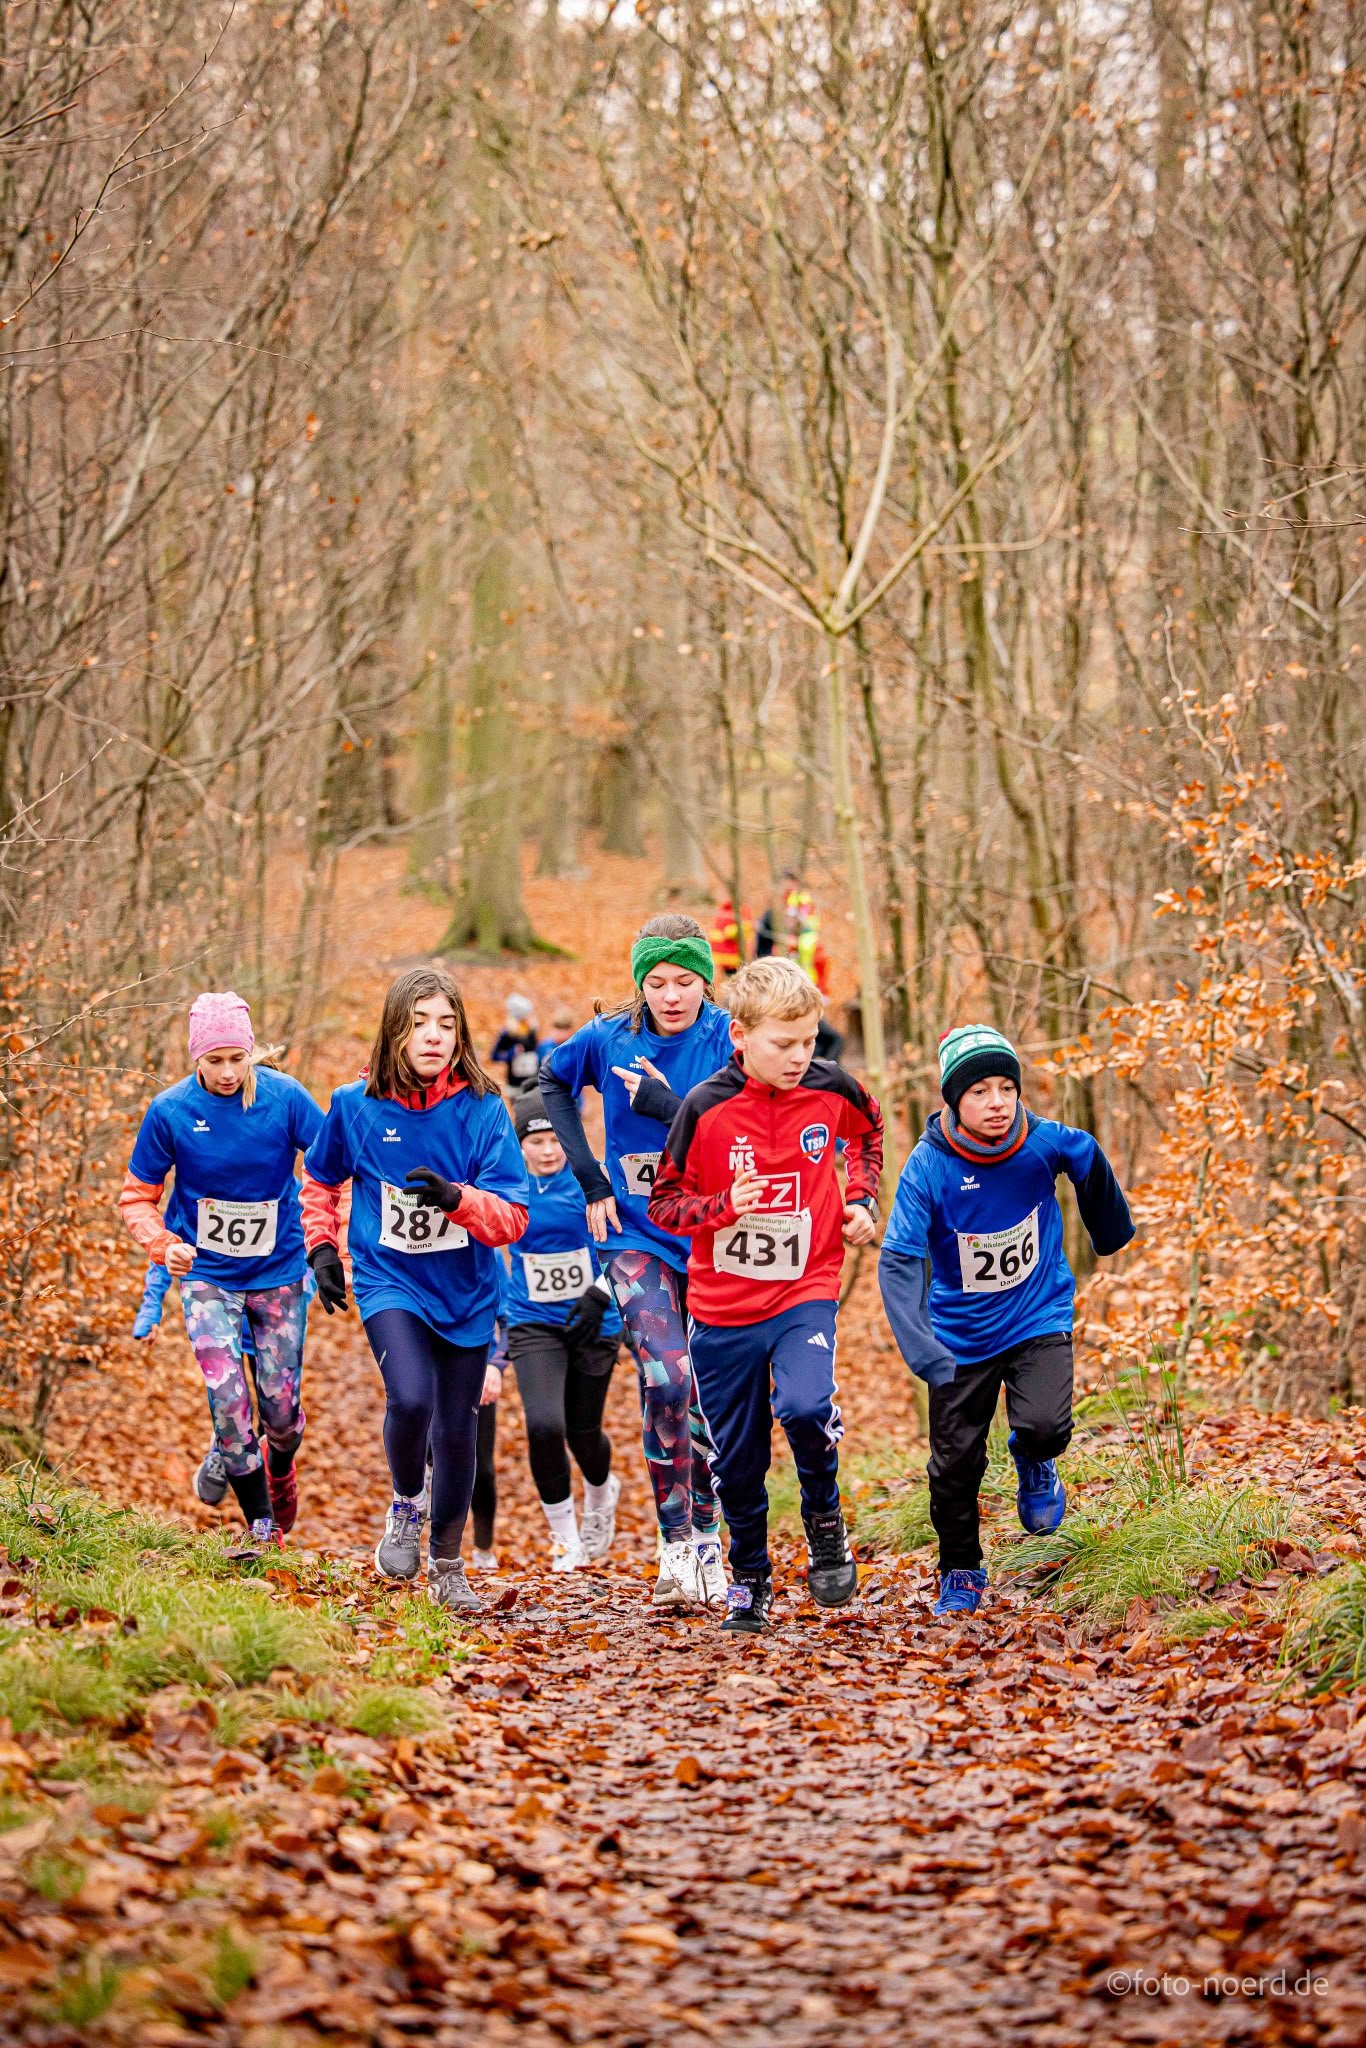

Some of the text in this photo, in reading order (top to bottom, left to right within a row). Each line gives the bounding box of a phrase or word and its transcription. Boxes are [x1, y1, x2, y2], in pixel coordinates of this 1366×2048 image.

[805, 1136, 825, 1152] TSB
[728, 1151, 756, 1171] MS
[960, 1183, 980, 1191] erima
[390, 1204, 452, 1242] 287
[740, 1223, 791, 1233] Nikolaus-Crosslauf
[749, 1215, 788, 1226] Glücksburger
[207, 1214, 268, 1246] 267
[983, 1229, 1028, 1249] Nikolaus-Crosslauf
[993, 1223, 1024, 1240] Glücksburger
[406, 1242, 433, 1250] Hanna
[725, 1231, 800, 1267] 431
[973, 1231, 1034, 1281] 266
[533, 1264, 584, 1292] 289
[1000, 1274, 1022, 1287] David
